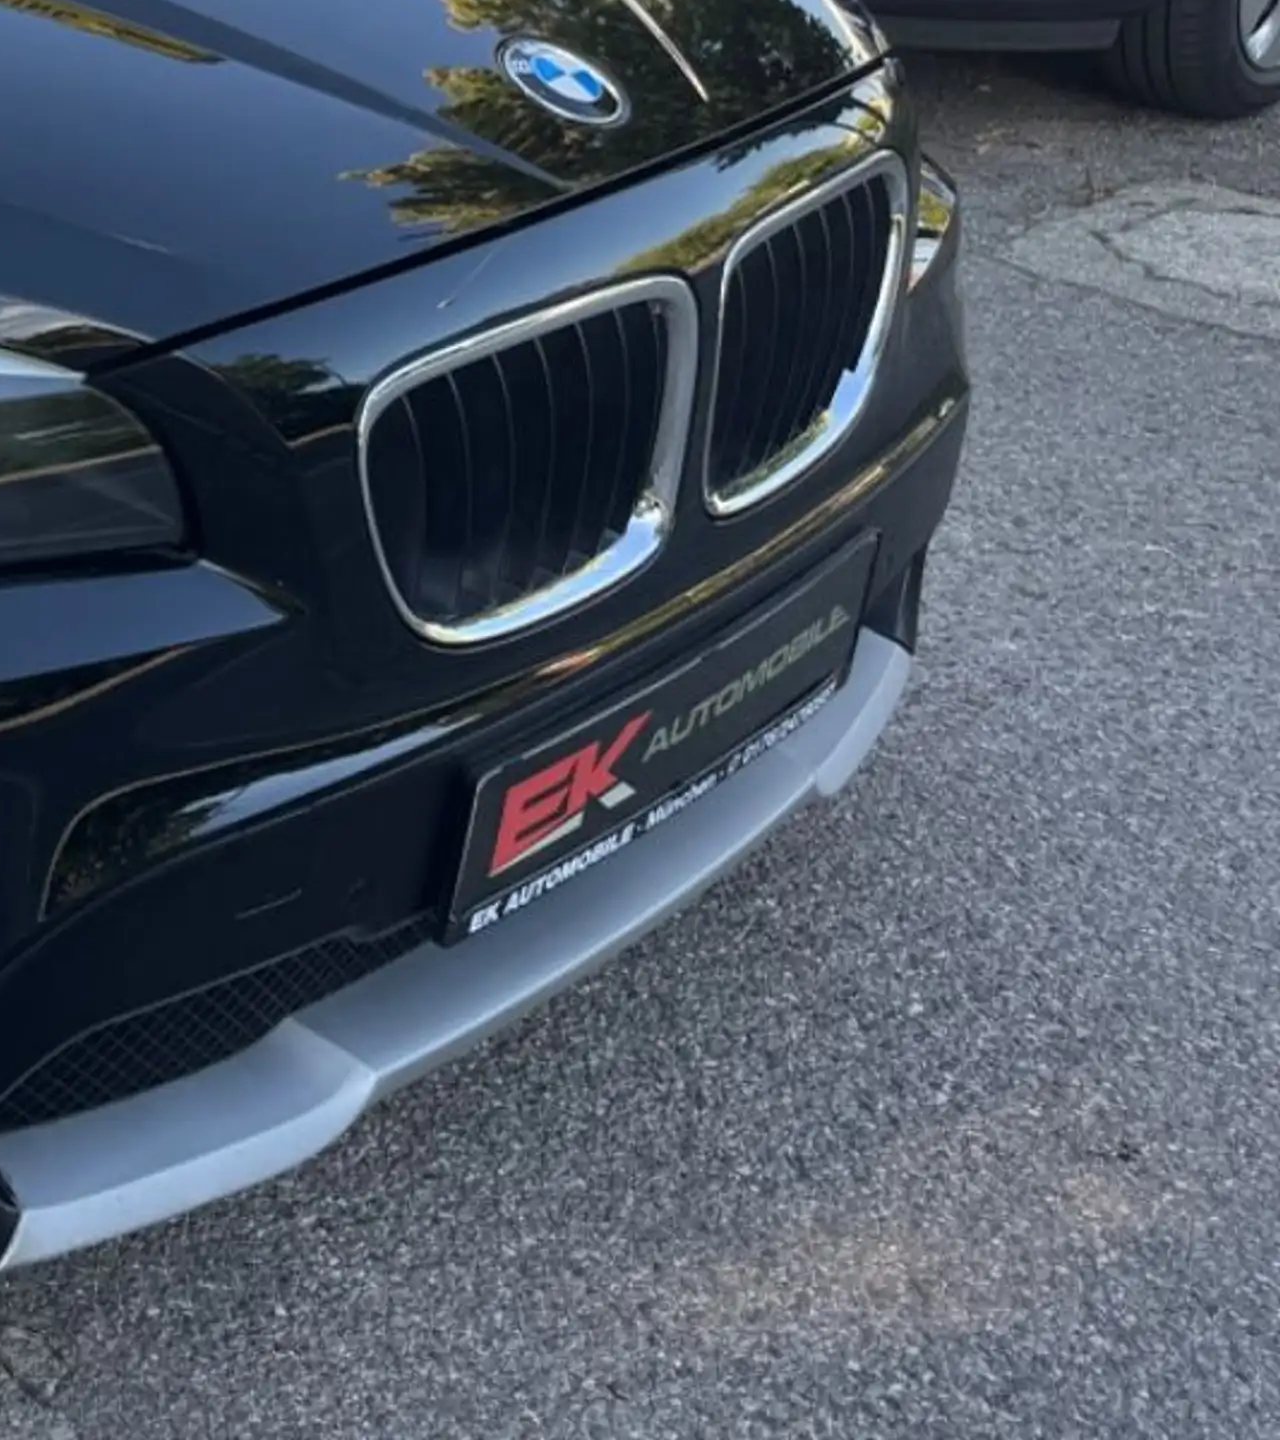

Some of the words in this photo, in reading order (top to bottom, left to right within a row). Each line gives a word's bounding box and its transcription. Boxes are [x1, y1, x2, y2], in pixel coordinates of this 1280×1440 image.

[489, 709, 653, 878] EK
[469, 900, 503, 934] EK
[503, 822, 637, 916] AUTOMOBILE
